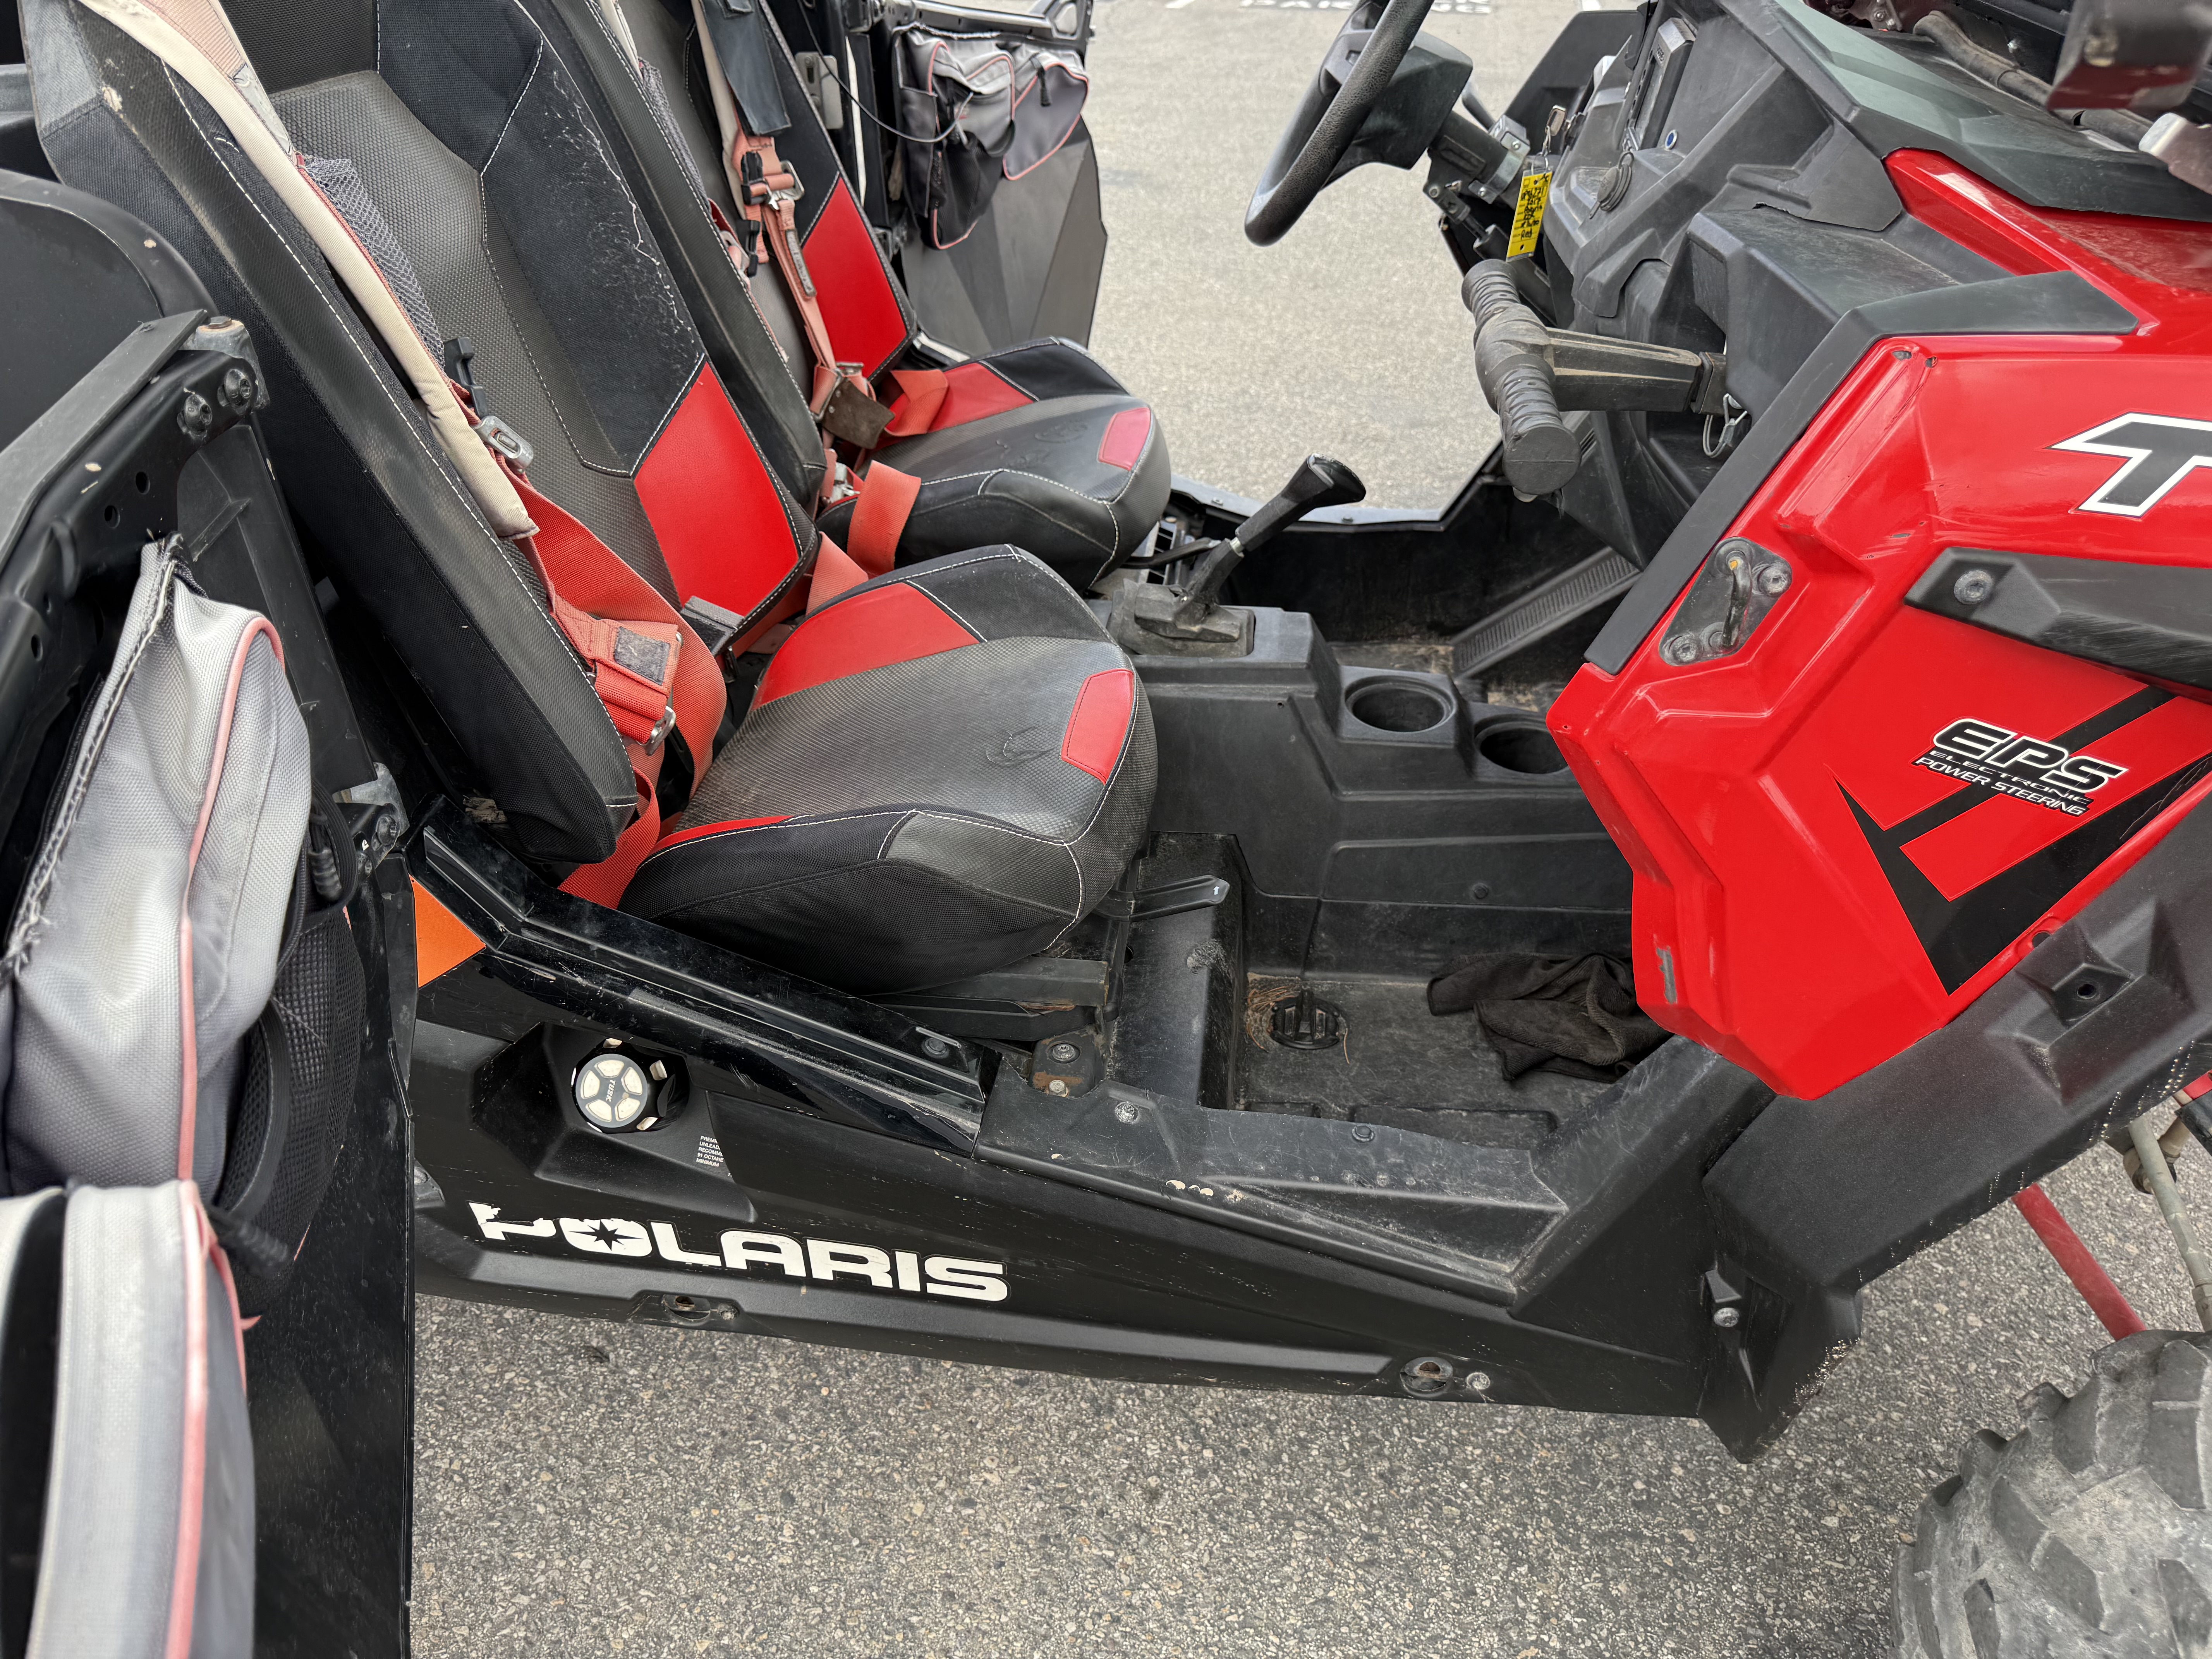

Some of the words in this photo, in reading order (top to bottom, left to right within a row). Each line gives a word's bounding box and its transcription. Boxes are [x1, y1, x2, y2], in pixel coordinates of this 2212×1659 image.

[1933, 718, 2129, 793] EPS
[1915, 757, 1992, 786] POWER
[1991, 781, 2087, 816] STEERING
[1929, 750, 2092, 805] ELECTRONIC
[605, 1080, 616, 1102] TUSK
[699, 1141, 721, 1150] UNLEAD
[696, 1158, 719, 1167] MINIMUM
[704, 1154, 724, 1163] OCTANE
